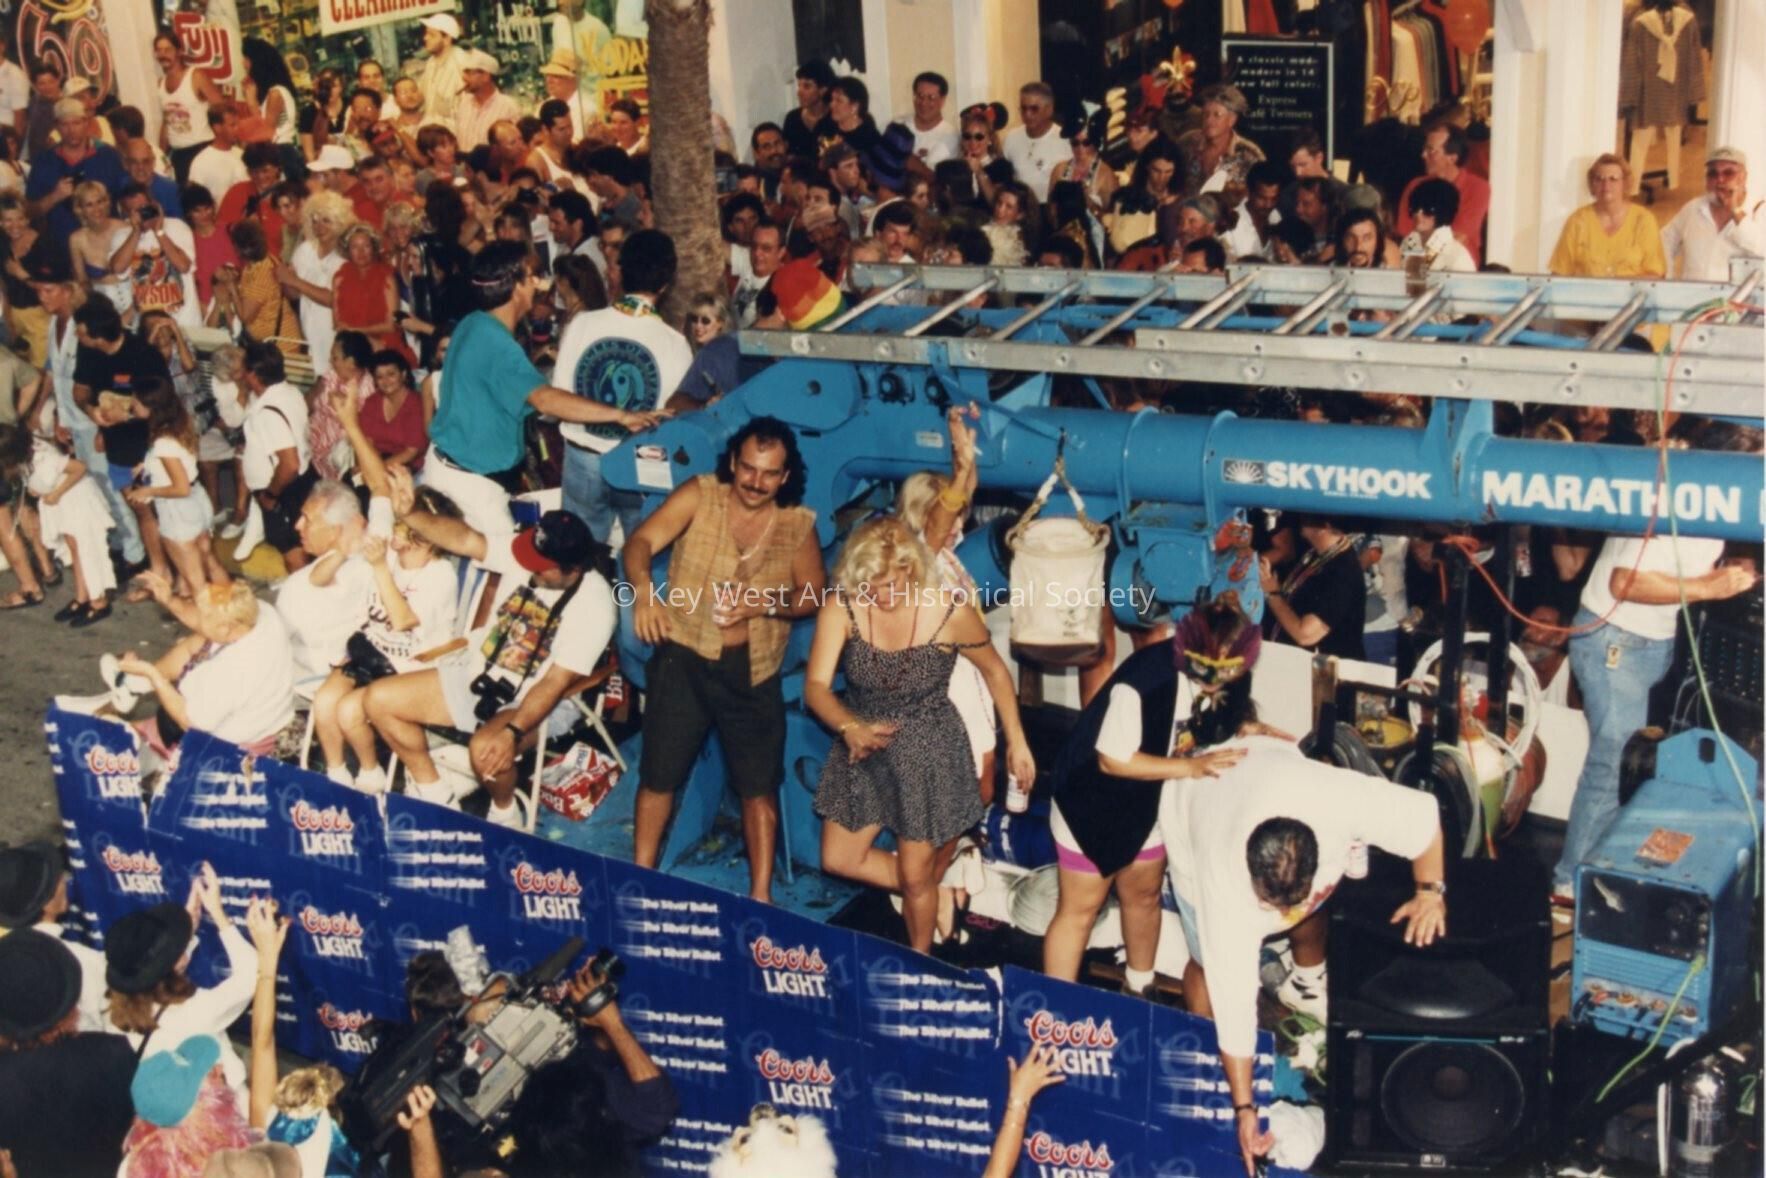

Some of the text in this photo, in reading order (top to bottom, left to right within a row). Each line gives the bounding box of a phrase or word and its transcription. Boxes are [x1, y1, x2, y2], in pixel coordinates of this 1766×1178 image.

[580, 30, 648, 76] KODA
[1266, 461, 1432, 499] SKYHOOK
[1482, 470, 1741, 523] MARATHON
[289, 799, 355, 832] Coors
[103, 844, 162, 874] Coors
[301, 831, 354, 855] LIGHT
[511, 862, 582, 897] Coors
[299, 905, 364, 937] Coors
[523, 895, 581, 920] LIGHT
[313, 935, 364, 958] LIGHT
[750, 936, 827, 973] Coors
[763, 970, 826, 998] LIGHT
[1024, 1010, 1118, 1047] Coors
[756, 1048, 835, 1085] Coors
[769, 1082, 832, 1110] LIGHT
[1024, 1131, 1115, 1169] Coors
